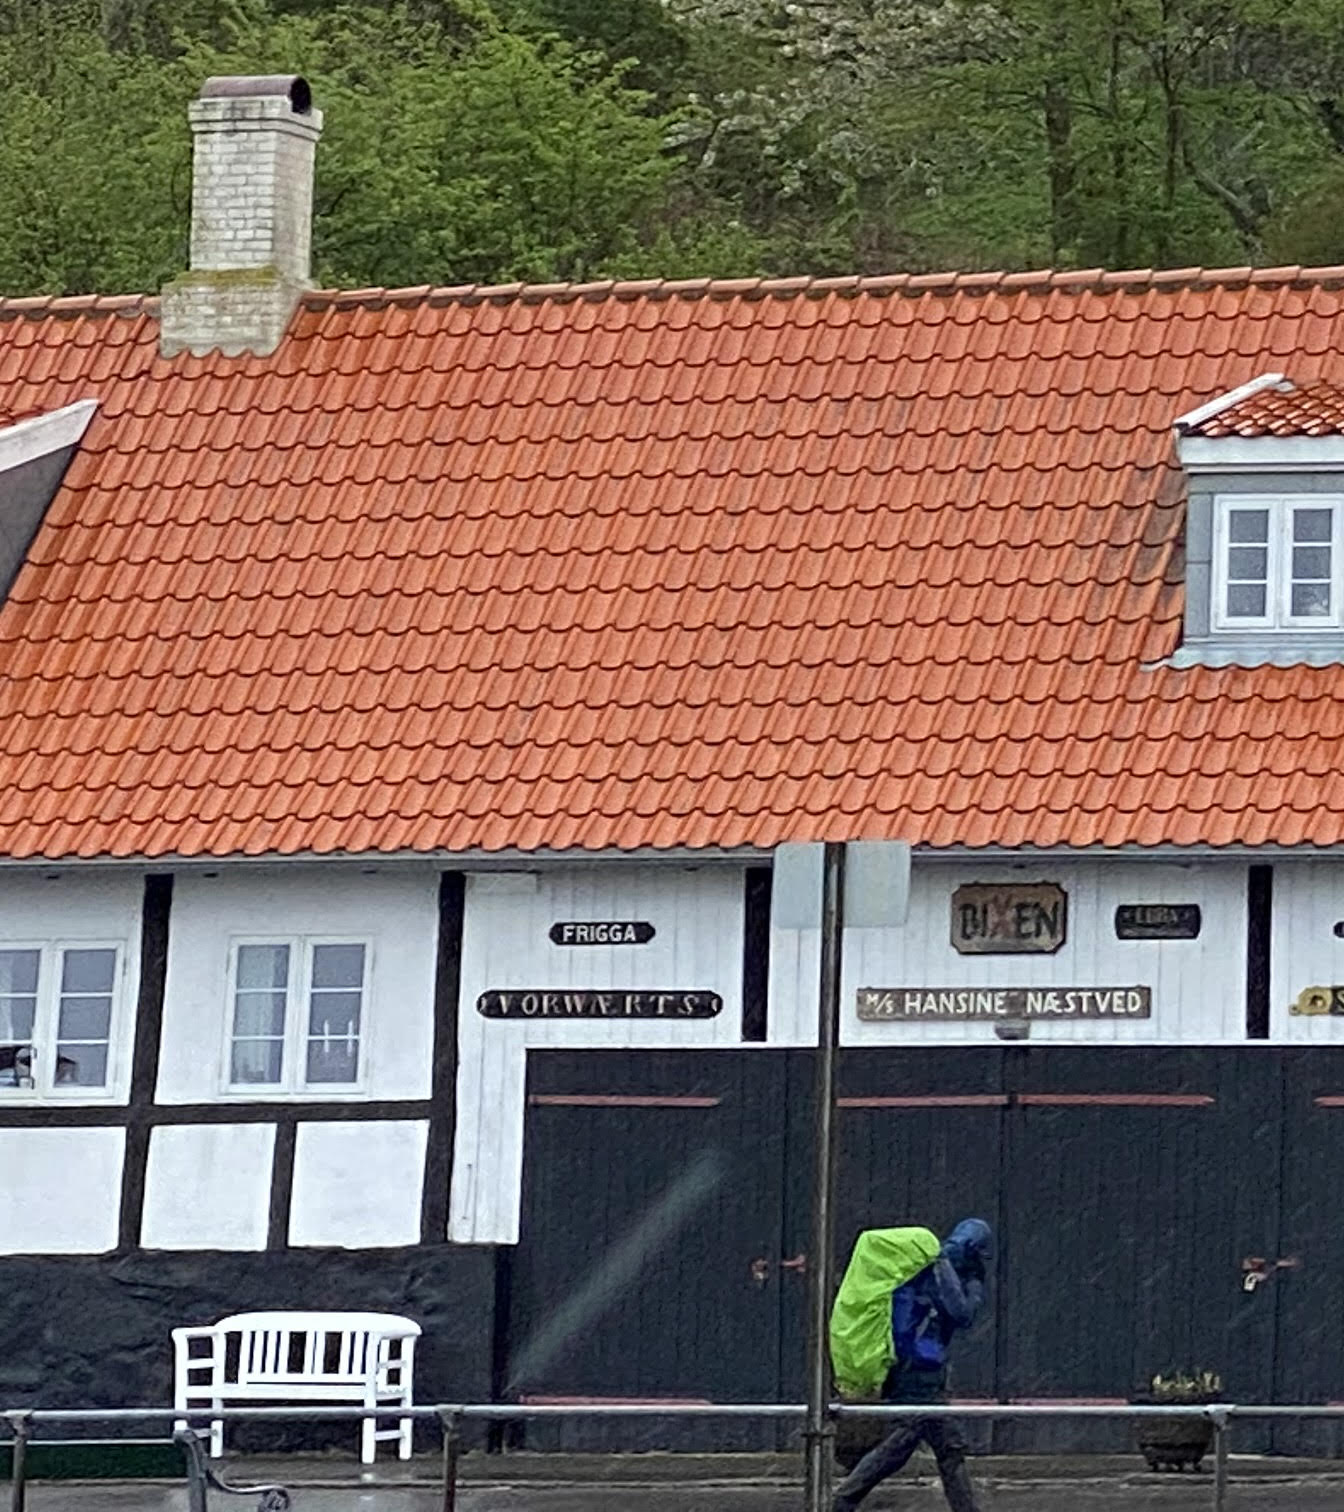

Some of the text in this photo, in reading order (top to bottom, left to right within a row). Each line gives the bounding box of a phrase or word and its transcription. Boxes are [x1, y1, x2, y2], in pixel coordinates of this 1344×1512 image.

[562, 924, 637, 943] FRIGGA
[904, 991, 1008, 1014] HANSINE
[1026, 991, 1142, 1014] NÆSTVED
